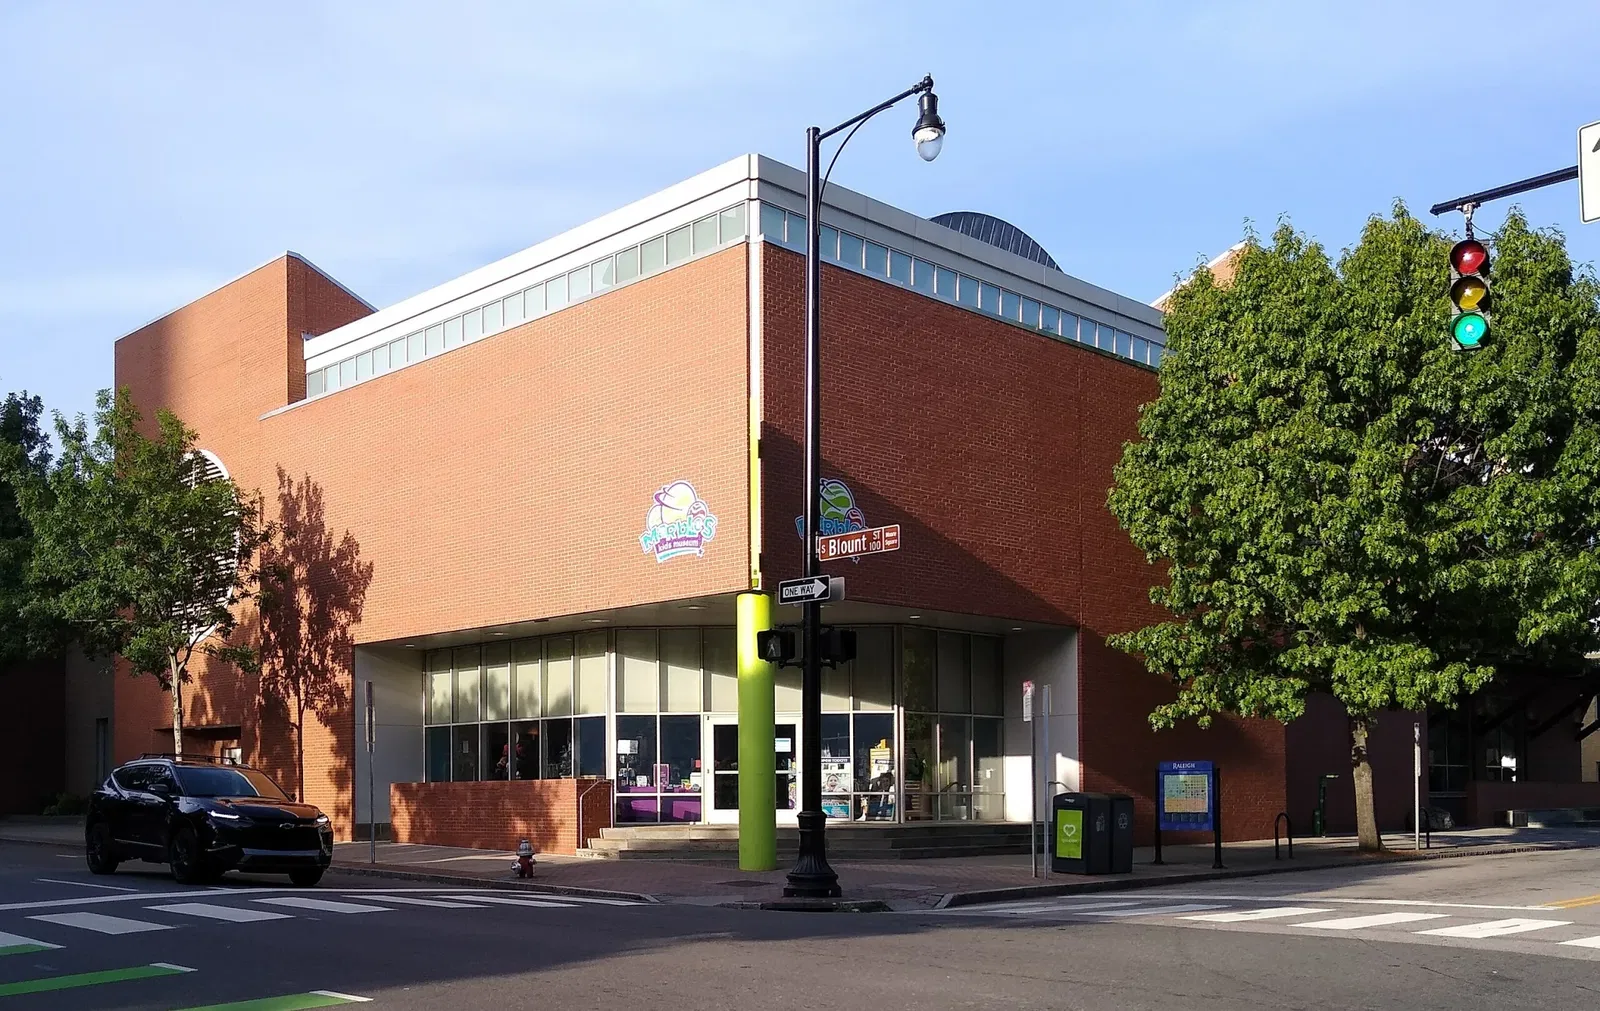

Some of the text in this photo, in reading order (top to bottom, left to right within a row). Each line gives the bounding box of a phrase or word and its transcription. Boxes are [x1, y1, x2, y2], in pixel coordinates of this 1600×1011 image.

[821, 530, 881, 556] S Blount ST
[869, 540, 881, 551] 100
[784, 584, 815, 597] ONE WAY
[1172, 762, 1196, 770] RALEIGH
